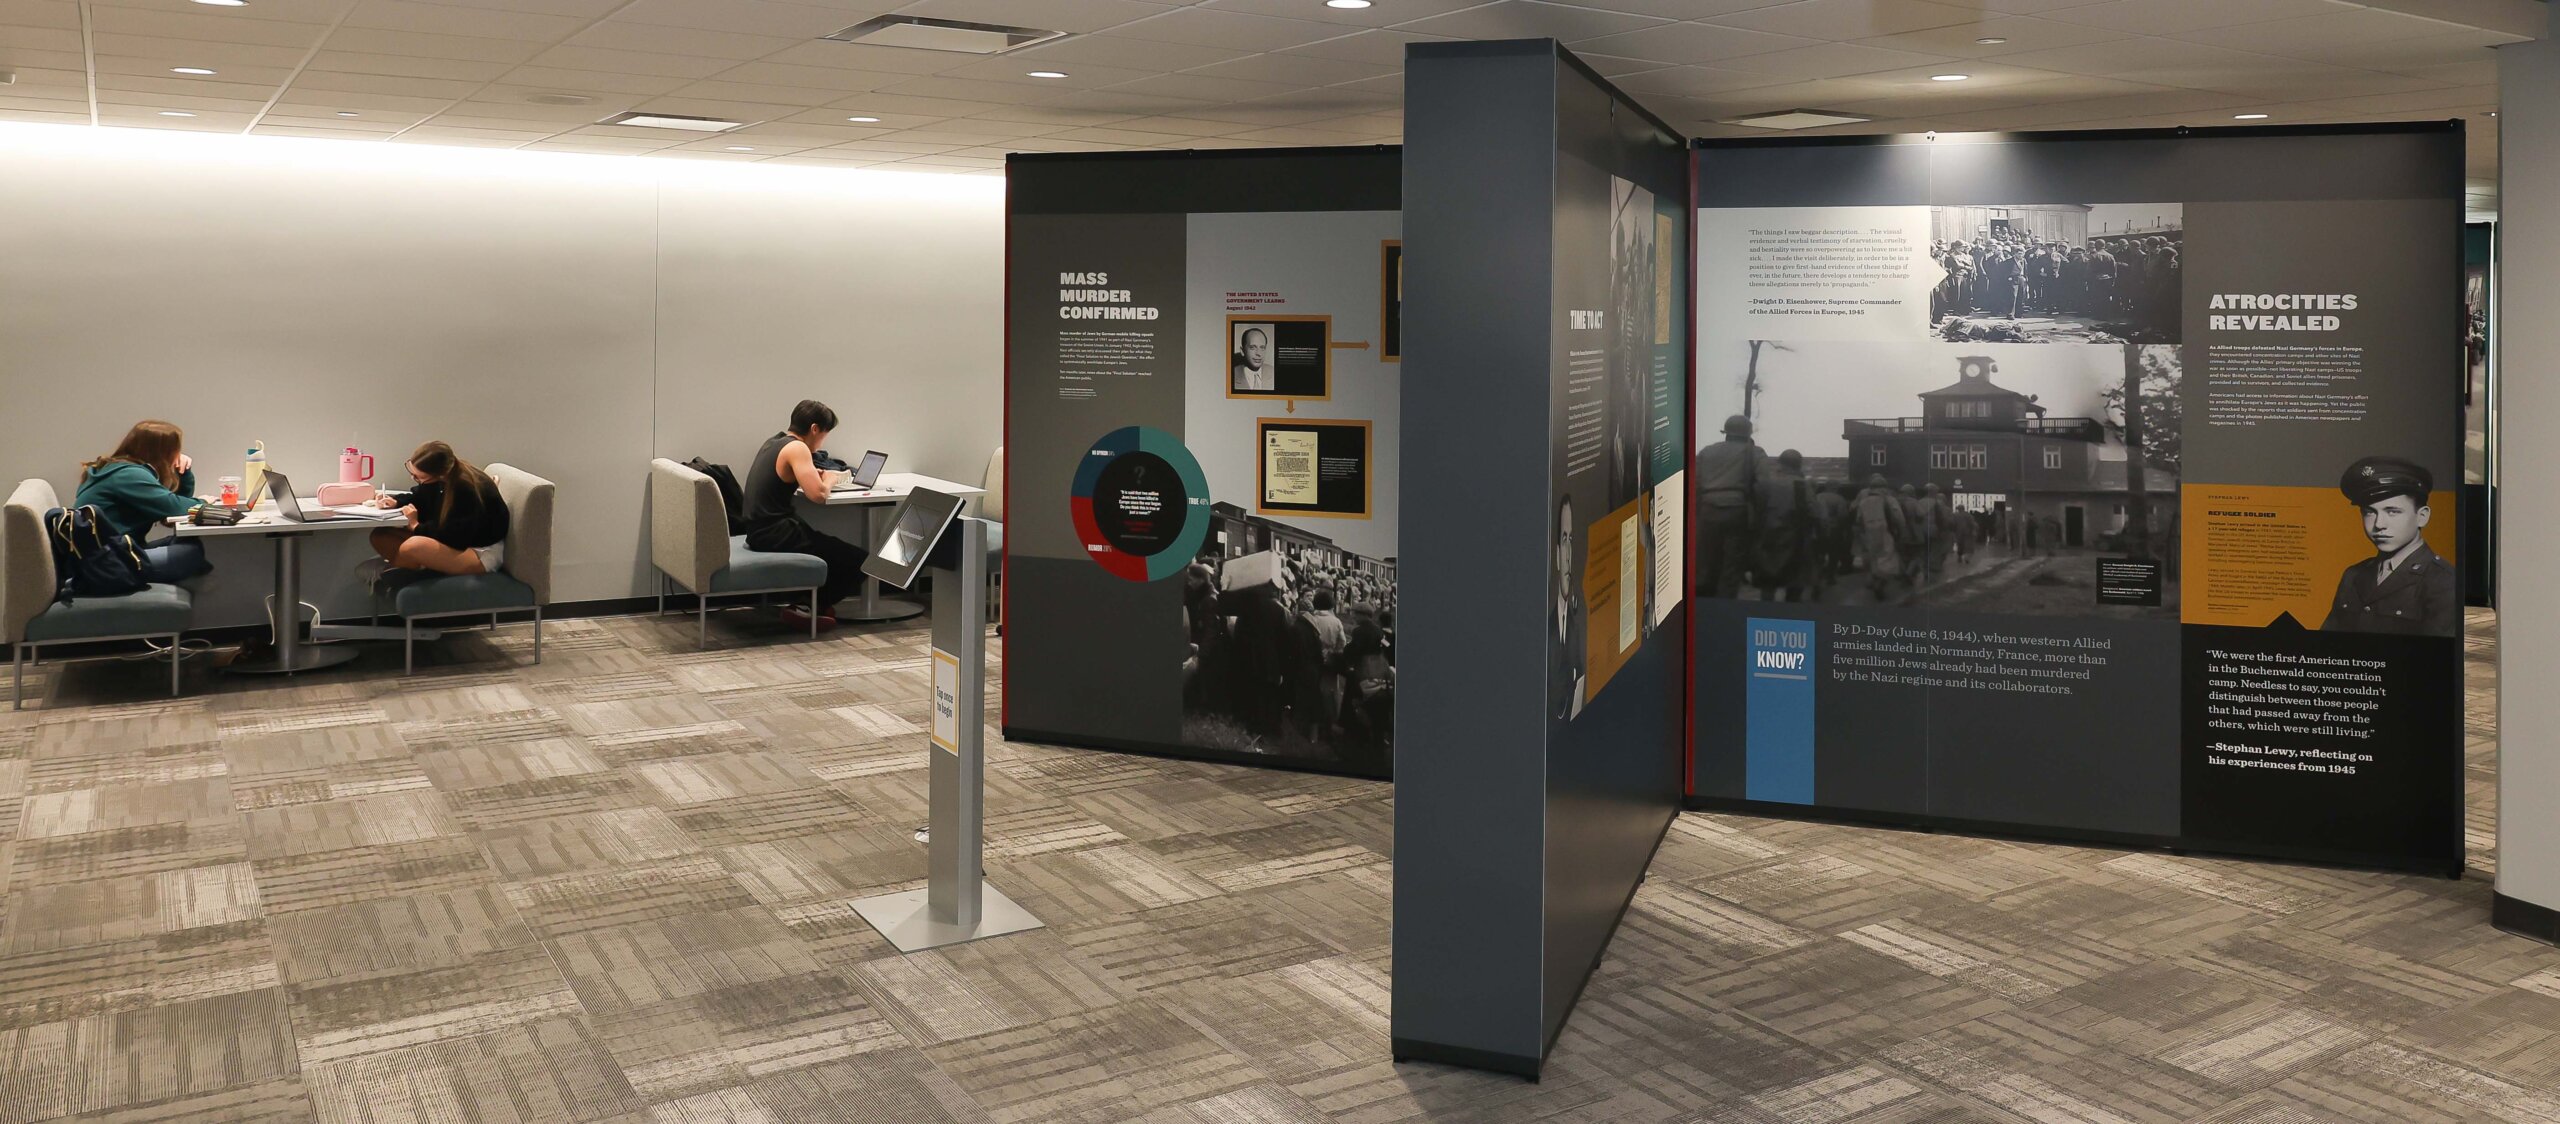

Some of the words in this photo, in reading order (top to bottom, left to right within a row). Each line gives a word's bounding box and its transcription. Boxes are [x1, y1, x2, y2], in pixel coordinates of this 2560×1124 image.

[1060, 273, 1107, 285] MASS
[1060, 290, 1130, 302] MURDER
[2210, 295, 2357, 309] ATROCITIES
[1060, 306, 1158, 320] CONFIRMED
[1570, 310, 1586, 329] TIME
[1587, 310, 1594, 329] TO
[1594, 310, 1603, 329] ACT
[2210, 316, 2340, 330] REVEALED
[1755, 630, 1777, 647] DID
[1779, 631, 1807, 649] YOU
[1834, 624, 1849, 635] By
[1852, 625, 1890, 637] D-Day
[1892, 627, 1928, 639] (June
[1928, 630, 1939, 640] 6,
[1943, 630, 1980, 643] 1944),
[1983, 632, 2017, 644] when
[2020, 637, 2070, 647] western
[2073, 637, 2111, 649] Allied
[1757, 651, 1804, 669] KNOW?
[1833, 641, 1872, 650] armies
[1874, 642, 1912, 652] landed
[1916, 644, 1929, 654] in
[1930, 645, 1994, 659] Normandy,
[1997, 649, 2041, 661] France,
[2045, 654, 2075, 663] more
[2079, 654, 2106, 664] than
[2257, 653, 2273, 661] the
[2276, 654, 2297, 663] first
[2299, 656, 2349, 666] American
[2352, 659, 2386, 669] troops
[1833, 655, 1853, 664] five
[1855, 656, 1895, 667] million
[1898, 658, 1928, 669] Jews
[1928, 660, 1973, 674] already
[1975, 663, 1996, 674] had
[2000, 665, 2029, 676] been
[2029, 666, 2089, 680] murdered
[2221, 665, 2238, 673] the
[2240, 666, 2304, 677] Buchenwald
[2307, 671, 2381, 682] concentration
[1834, 670, 1847, 681] by
[1849, 670, 1868, 681] the
[1870, 672, 1898, 683] Nazi
[1902, 674, 1942, 687] regime
[1945, 677, 1967, 688] and
[1970, 679, 1985, 689] its
[1988, 680, 2072, 694] collaborators.
[2209, 680, 2238, 688] camp.
[2241, 680, 2287, 690] Needless
[2301, 685, 2320, 694] say,
[2322, 686, 2341, 695] you
[2343, 686, 2386, 696] couldn't
[944, 692, 953, 704] once
[2209, 692, 2266, 703] distinguish
[2268, 695, 2311, 705] between
[2313, 698, 2341, 707] those
[2344, 700, 2378, 710] people
[937, 701, 941, 711] to
[942, 702, 952, 718] begin
[2209, 706, 2230, 714] that
[2233, 707, 2252, 715] had
[2254, 708, 2290, 719] passed
[2293, 713, 2320, 721] away
[2323, 712, 2350, 722] from
[2353, 714, 2370, 723] the
[2209, 720, 2245, 729] others,
[2248, 722, 2280, 731] which
[2312, 726, 2333, 735] still
[2264, 746, 2298, 757] Lewy,
[2300, 749, 2356, 762] reflecting
[2209, 757, 2226, 765] his
[2228, 759, 2296, 770] experiences
[2298, 762, 2326, 772] from
[2329, 765, 2355, 774] 1945
